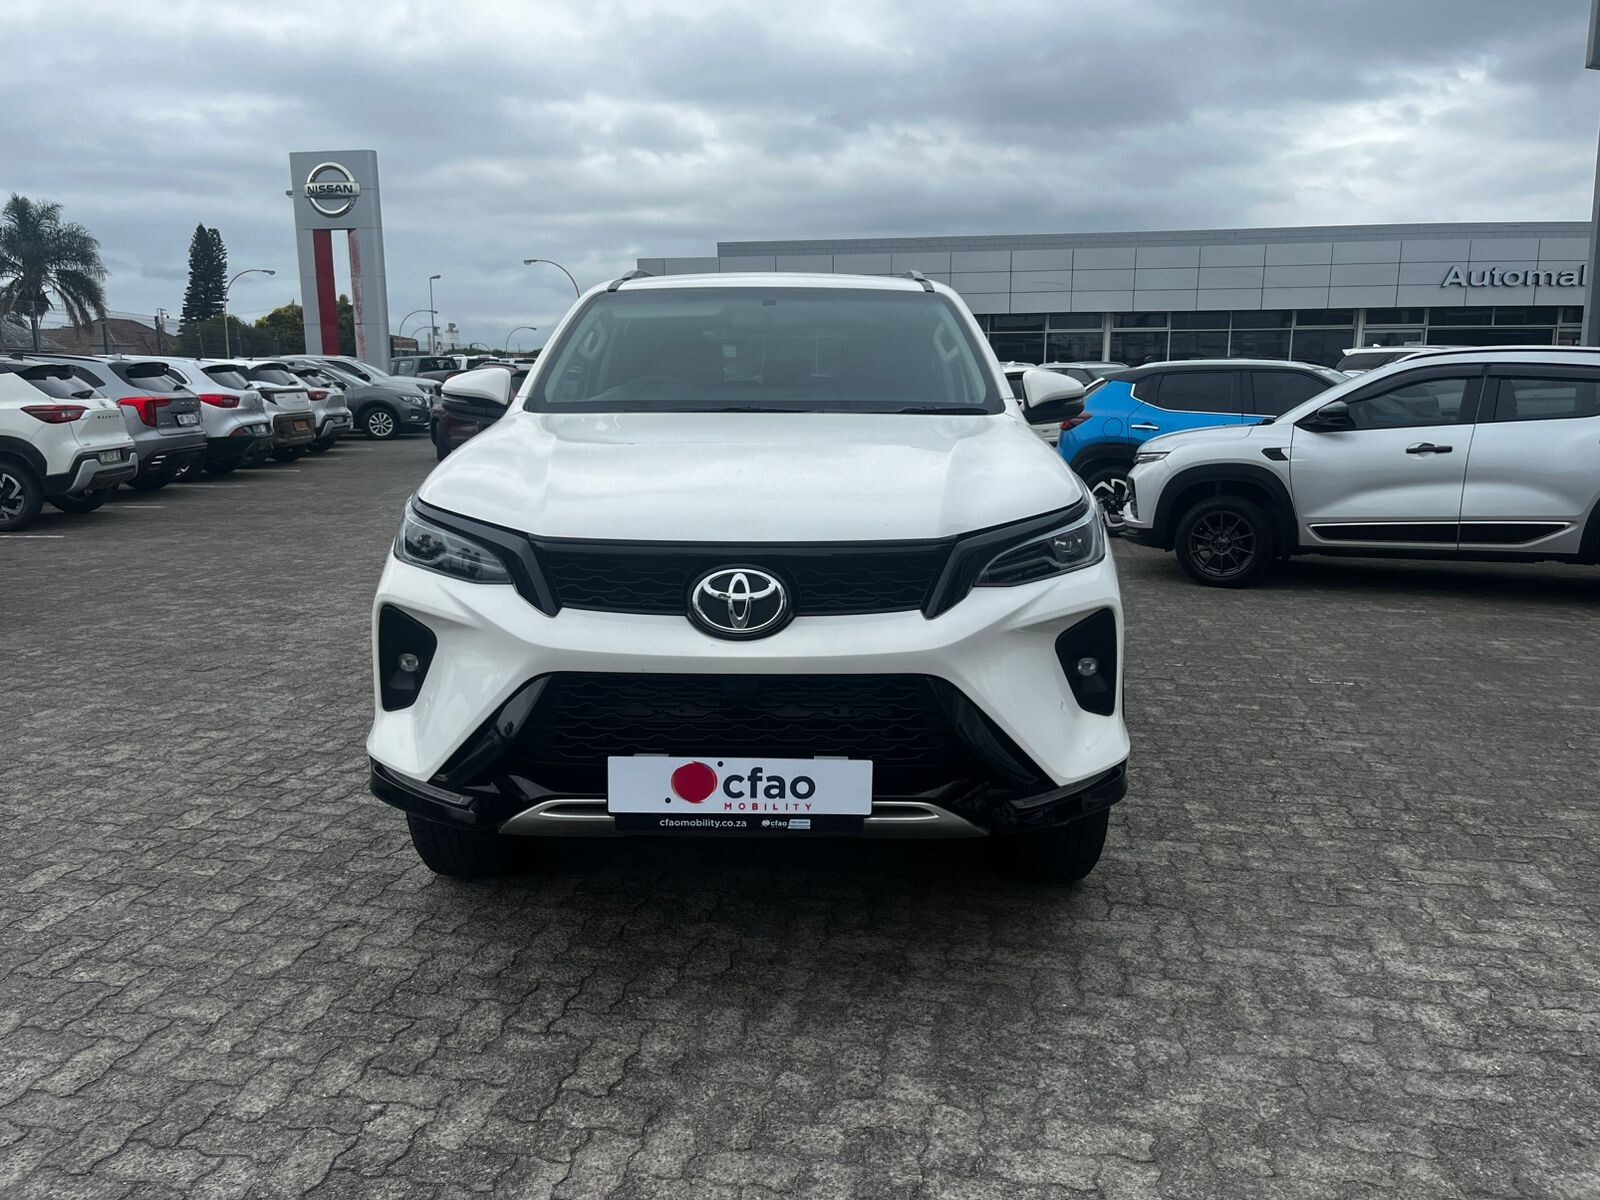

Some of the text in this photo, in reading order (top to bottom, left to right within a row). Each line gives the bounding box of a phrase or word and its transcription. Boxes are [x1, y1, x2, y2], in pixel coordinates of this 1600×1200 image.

[307, 184, 354, 194] NISSAN
[722, 766, 816, 800] cfao
[724, 802, 812, 811] MOBILITY
[659, 818, 747, 828] cfaomobility.co.za
